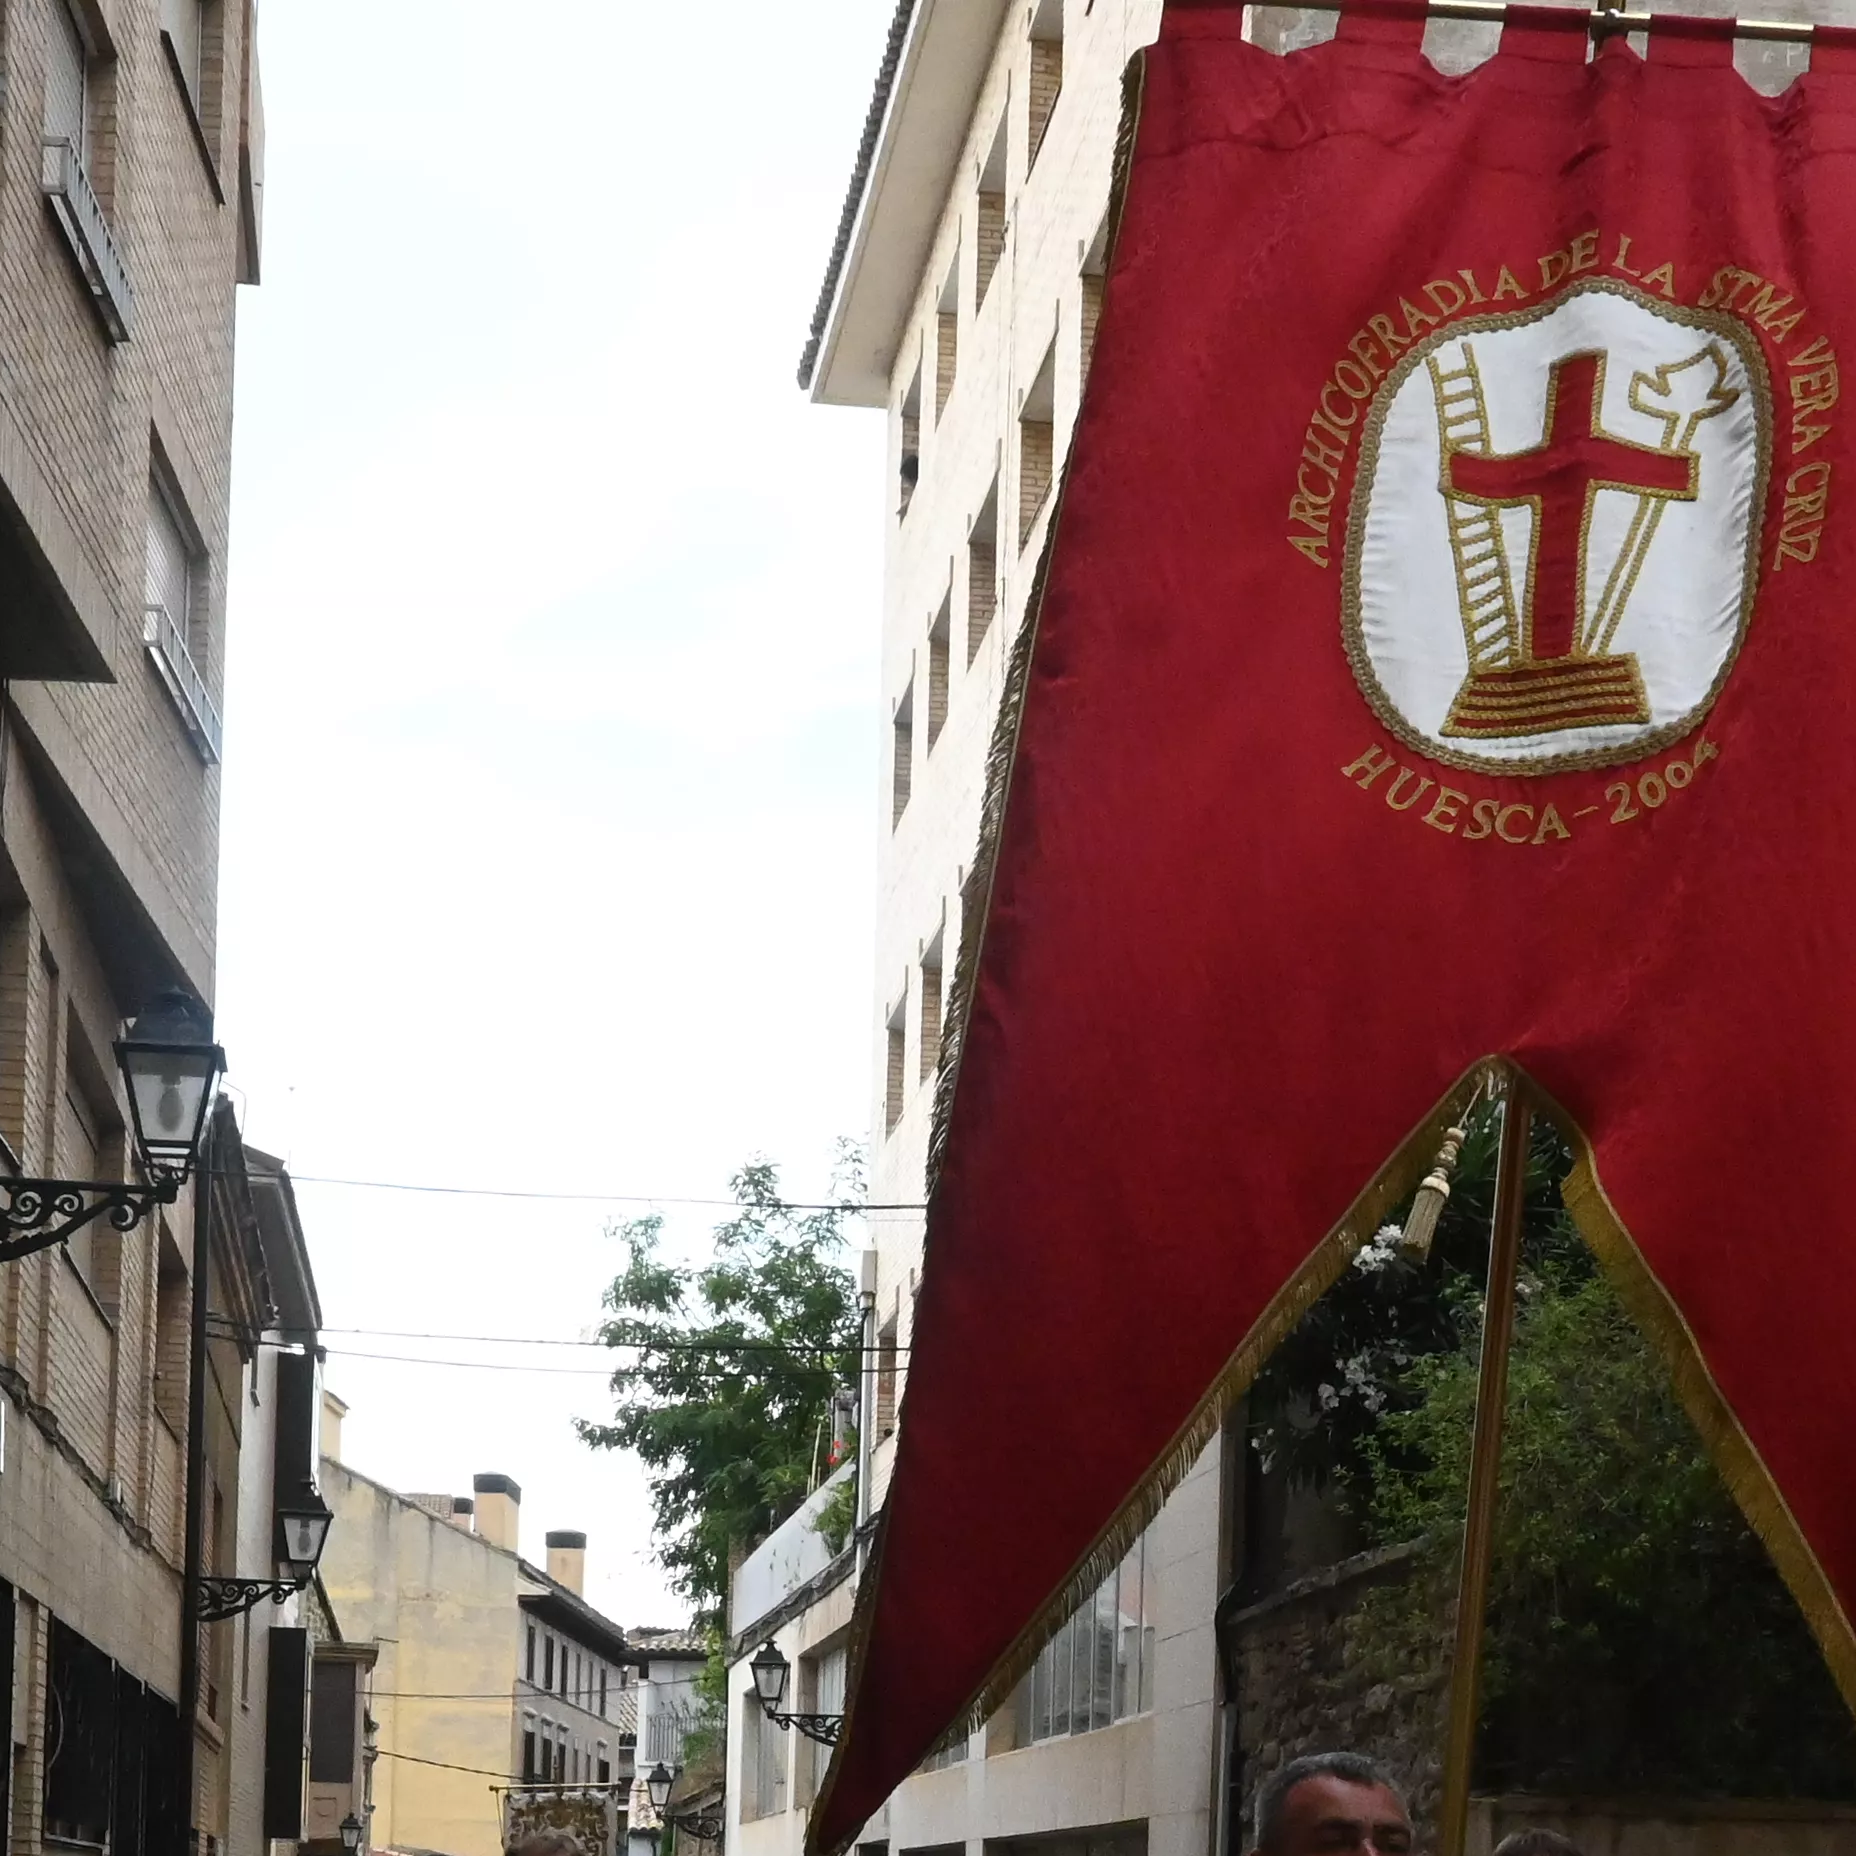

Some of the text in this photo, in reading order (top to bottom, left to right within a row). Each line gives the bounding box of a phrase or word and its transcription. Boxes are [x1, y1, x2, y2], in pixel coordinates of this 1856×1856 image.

[1538, 229, 1601, 291] DE
[1612, 233, 1675, 299] LA
[1287, 265, 1529, 568] ARCHICOFRADIA
[1787, 335, 1839, 454] VERA
[1772, 461, 1832, 572] CRUZ
